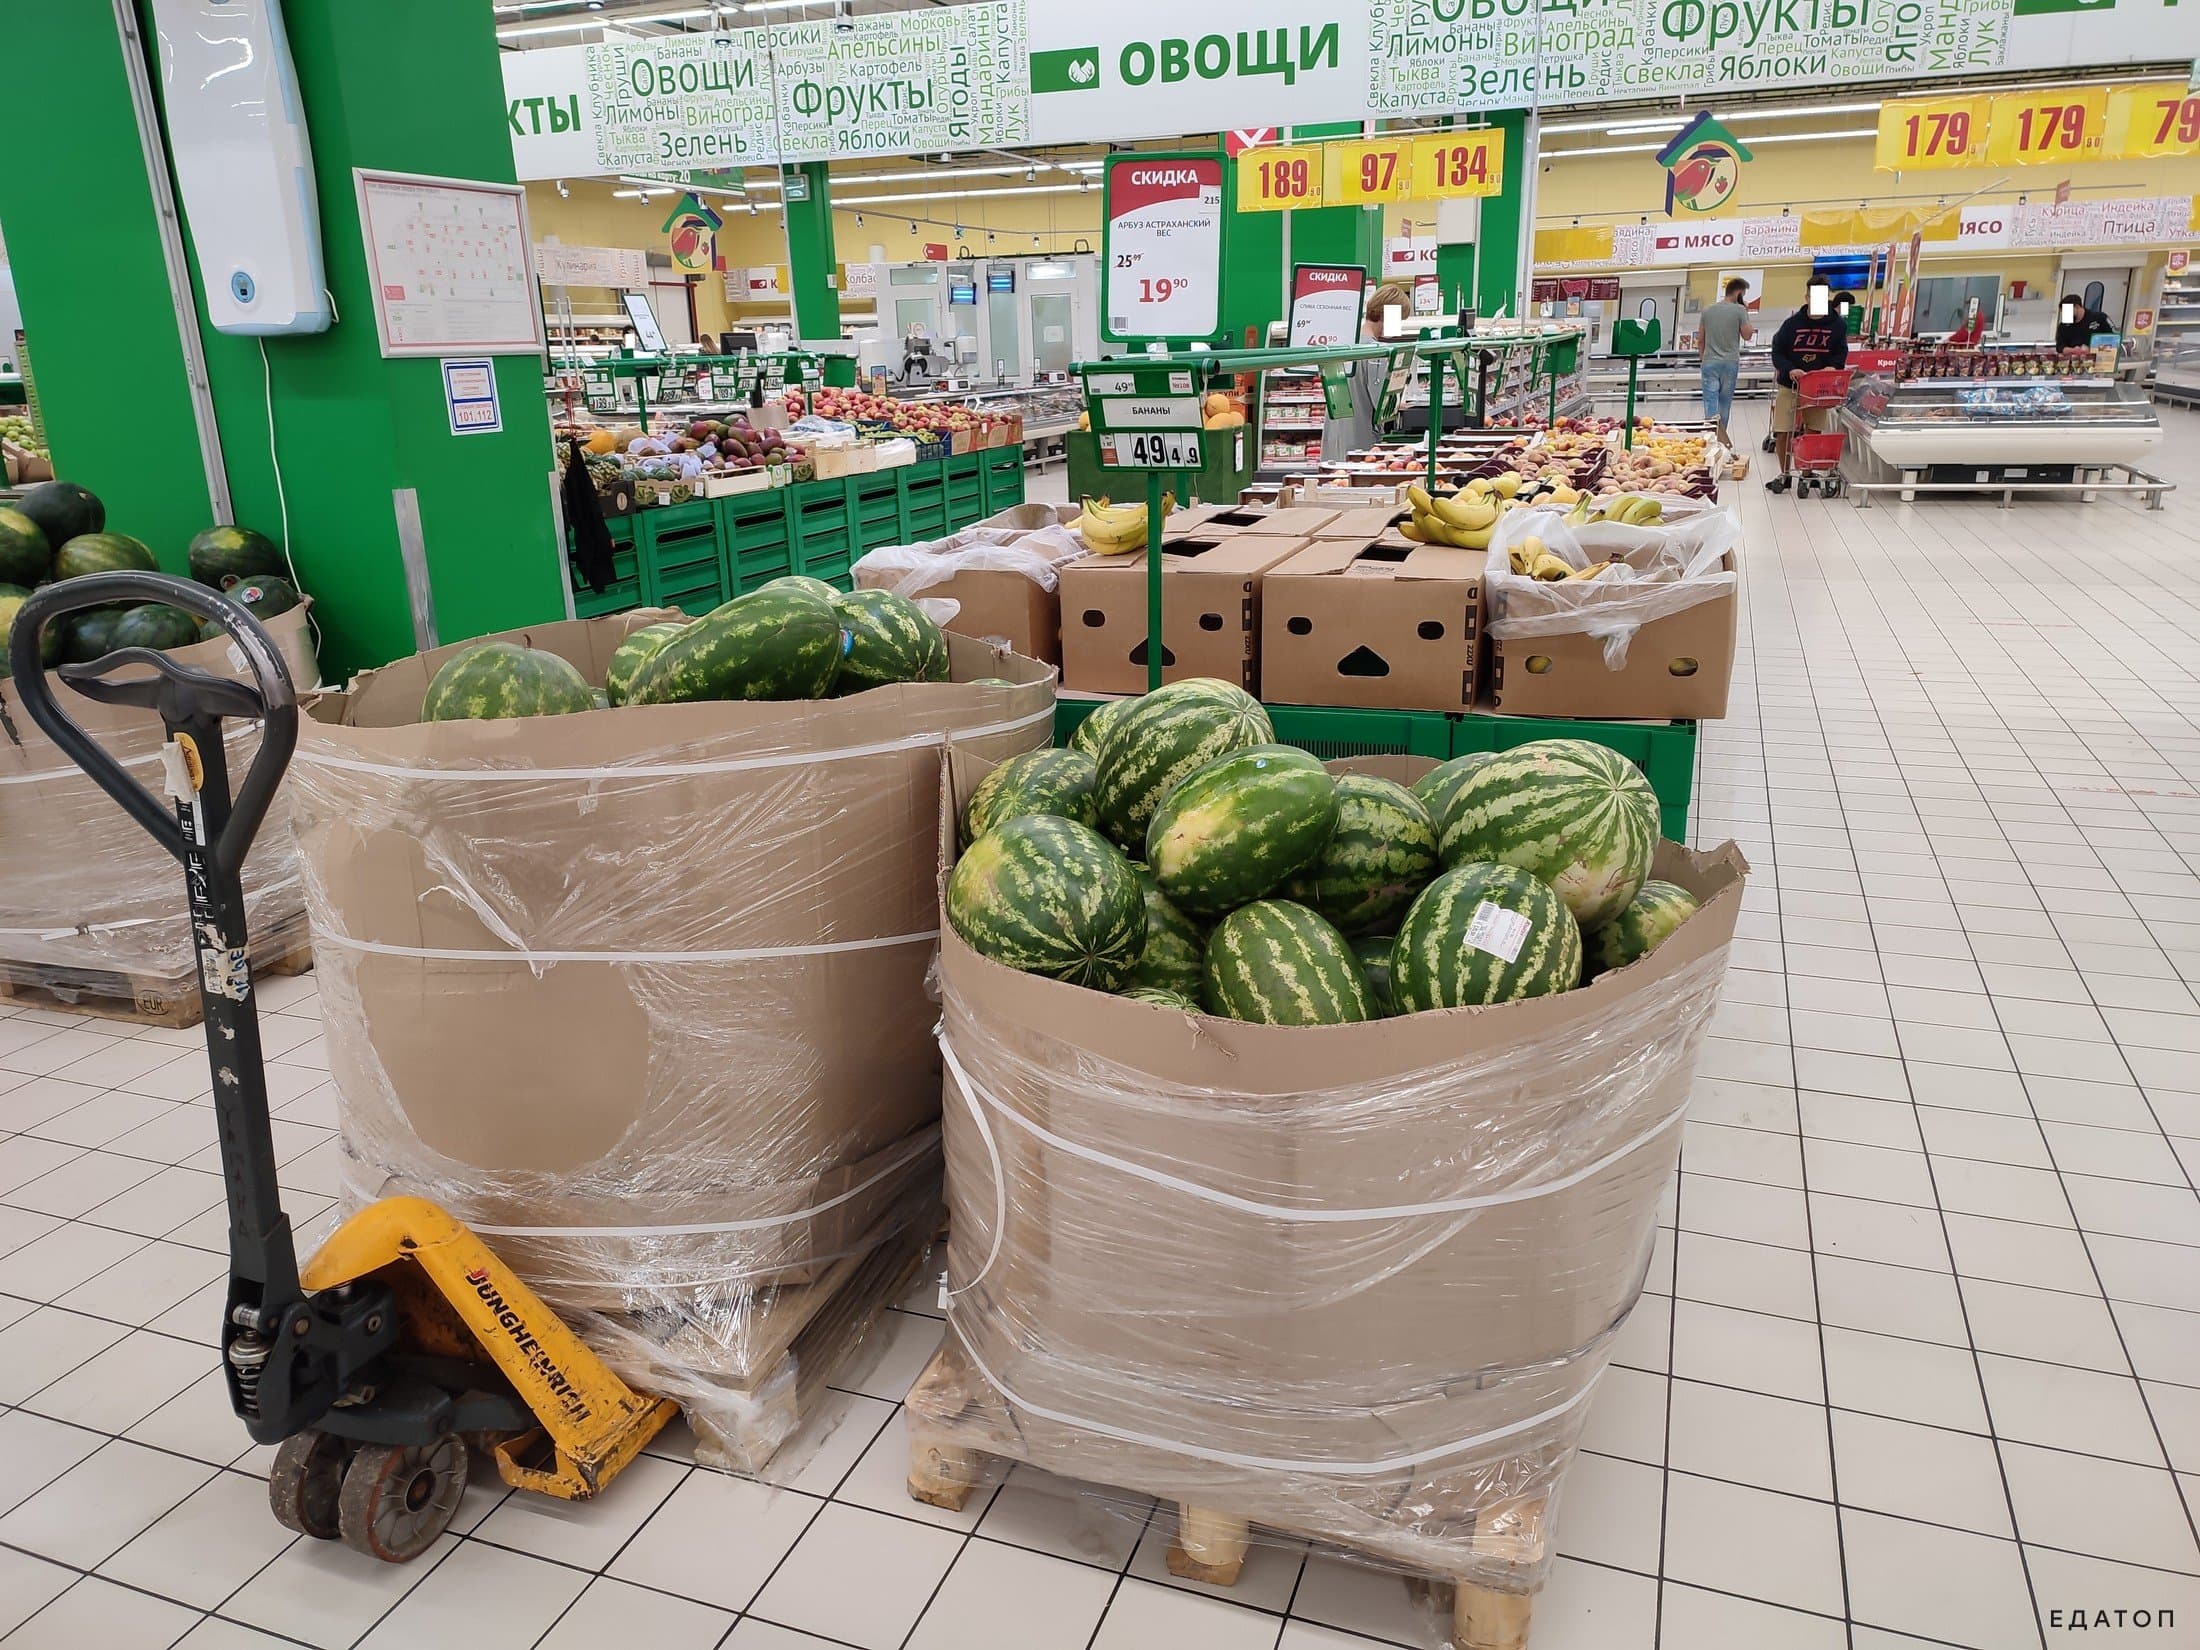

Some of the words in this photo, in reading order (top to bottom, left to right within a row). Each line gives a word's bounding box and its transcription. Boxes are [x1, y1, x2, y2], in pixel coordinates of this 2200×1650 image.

[900, 15, 961, 32] Морковь
[1503, 15, 1547, 29] Фрукты
[1577, 8, 1614, 20] Чеснок
[833, 20, 894, 35] Балажаны
[966, 7, 977, 47] Салат
[1449, 21, 1496, 35] Бананы
[1546, 15, 1628, 34] Апельсины
[1640, 0, 1658, 66] Кабачки
[1661, 0, 1868, 51] Фрукты
[1919, 5, 1935, 47] Укроп
[665, 37, 705, 49] Лимоны
[711, 36, 743, 49] Пец
[743, 28, 821, 50] Персики
[853, 30, 899, 42] Картофель
[995, 3, 1012, 84] Капуста
[1386, 30, 1494, 59] Лимоны
[1504, 27, 1635, 57] Виноград
[1766, 32, 1794, 42] Тыква
[1803, 33, 1864, 49] Томаты
[1862, 33, 1894, 46] Редис
[1952, 17, 1971, 69] Яблоки
[1967, 18, 1999, 67] Лук
[656, 46, 702, 60] Бананы
[827, 34, 940, 61] Апельсины
[1118, 23, 1339, 87] ОВОЩИ
[1654, 46, 1709, 61] Персики
[1757, 41, 1803, 56] Перец
[1831, 46, 1883, 60] Капуста
[1409, 56, 1446, 68] Яблоки
[1457, 52, 1495, 64] Бананы
[1718, 53, 1826, 82] Яблоки
[602, 44, 614, 100] Чеснок
[614, 47, 632, 107] Груши
[632, 58, 754, 97] Овощи
[777, 60, 825, 78] Арбузы
[849, 60, 922, 78] Картофель
[977, 5, 995, 145] Мандарины
[1388, 65, 1441, 83] Тыква
[1588, 51, 1599, 85] Груши
[1596, 48, 1612, 96] Редис
[1612, 53, 1624, 89] Тыква
[1623, 62, 1705, 85] Свекла
[1703, 54, 1716, 88] Грибы
[1830, 61, 1886, 79] Овощи
[587, 46, 602, 119] Клубника
[760, 64, 771, 92] Лук
[936, 52, 952, 114] Огурцы
[1366, 57, 1380, 108] Свекла
[1394, 80, 1446, 94] Картофель
[1446, 59, 1458, 105] Фрукты
[1458, 63, 1587, 98] Зелень
[948, 45, 971, 138] Ягоды
[995, 86, 1029, 99] Грибы
[1379, 90, 1447, 110] Капуста
[1502, 92, 1562, 104] Мандрины
[647, 96, 680, 107] Бананы
[714, 95, 770, 109] Апельсины
[781, 83, 792, 137] Кабачки
[792, 78, 933, 126] Фрукты
[970, 91, 979, 126] Укроп
[605, 103, 680, 125] Лимоны
[686, 104, 777, 128] Виноград
[891, 112, 933, 126] Томаты
[995, 102, 1004, 144] Яблоки
[1005, 103, 1024, 142] Лук
[791, 121, 830, 132] Персики
[861, 119, 893, 131] Перец
[911, 124, 947, 135] Капуста
[1905, 111, 1971, 158] 179
[2017, 104, 2086, 152] 179
[608, 131, 646, 145] Тыква
[660, 131, 748, 159] Зелень
[755, 122, 765, 160] Редис
[838, 129, 911, 152] Яблоки
[913, 138, 950, 150] Овощи
[605, 152, 653, 168] Капуста
[1434, 145, 1488, 188] 134
[1131, 169, 1199, 187] СКИДКА
[1258, 158, 1309, 199] 189
[1361, 152, 1398, 193] 97
[1204, 196, 1220, 205] 215
[1118, 220, 1144, 229] АРБУЗ
[1145, 217, 1211, 229] АСТРАХАНСКИЙ
[1744, 223, 1799, 237] Баранина
[1959, 220, 2003, 235] ЯСО
[2103, 220, 2156, 235] Птица
[1156, 229, 1172, 237] ВЕС
[1684, 233, 1734, 249] МЯСО
[1746, 243, 1801, 256] Телятина
[1309, 271, 1348, 283] СКИДКА
[1793, 333, 1831, 347] FOX
[1132, 406, 1171, 415] БАНАНЫ
[1133, 435, 1165, 465] 49
[143, 998, 164, 1011] EUR
